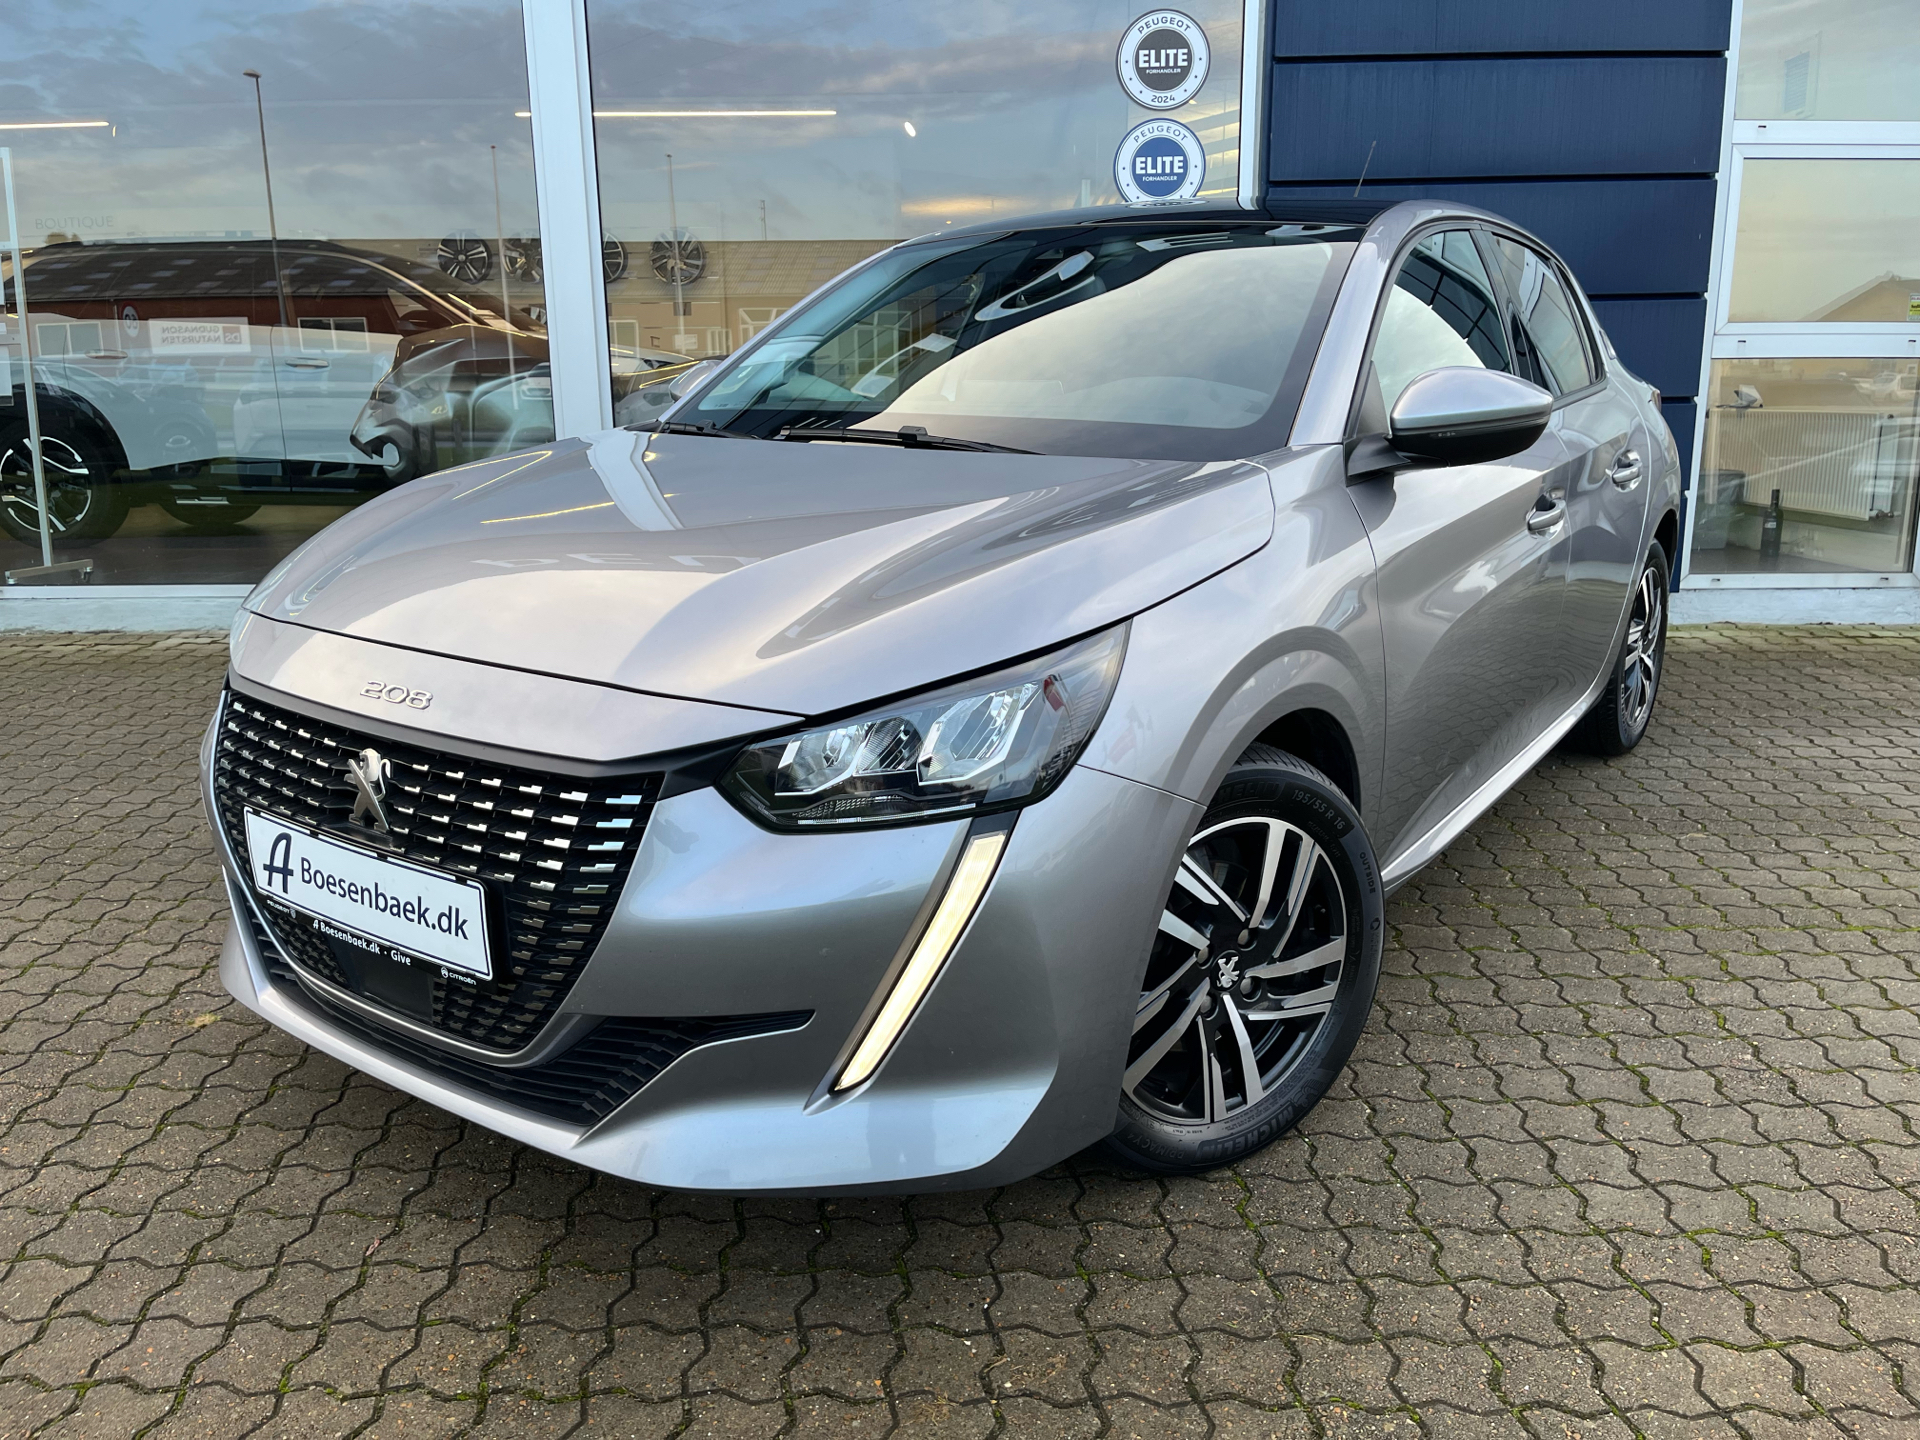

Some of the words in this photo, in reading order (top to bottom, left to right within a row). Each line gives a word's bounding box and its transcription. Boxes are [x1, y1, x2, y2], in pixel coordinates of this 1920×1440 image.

[1137, 16, 1191, 35] PEUGEOT
[1138, 48, 1189, 68] ELITE
[1151, 94, 1176, 104] 2024
[1133, 125, 1188, 144] PEUGEOT
[1135, 155, 1184, 175] ELITE
[34, 215, 115, 230] BOUTIQUE
[360, 680, 433, 710] 208
[1291, 789, 1328, 813] 195/55
[1325, 809, 1335, 820] R
[1333, 816, 1346, 830] 16
[1359, 851, 1376, 894] OUTSIDE
[300, 856, 469, 941] Boesenbaek.dk
[320, 921, 381, 955] Boesenbaek.dk
[390, 949, 411, 966] Give
[1199, 1105, 1295, 1161] MICHELIN
